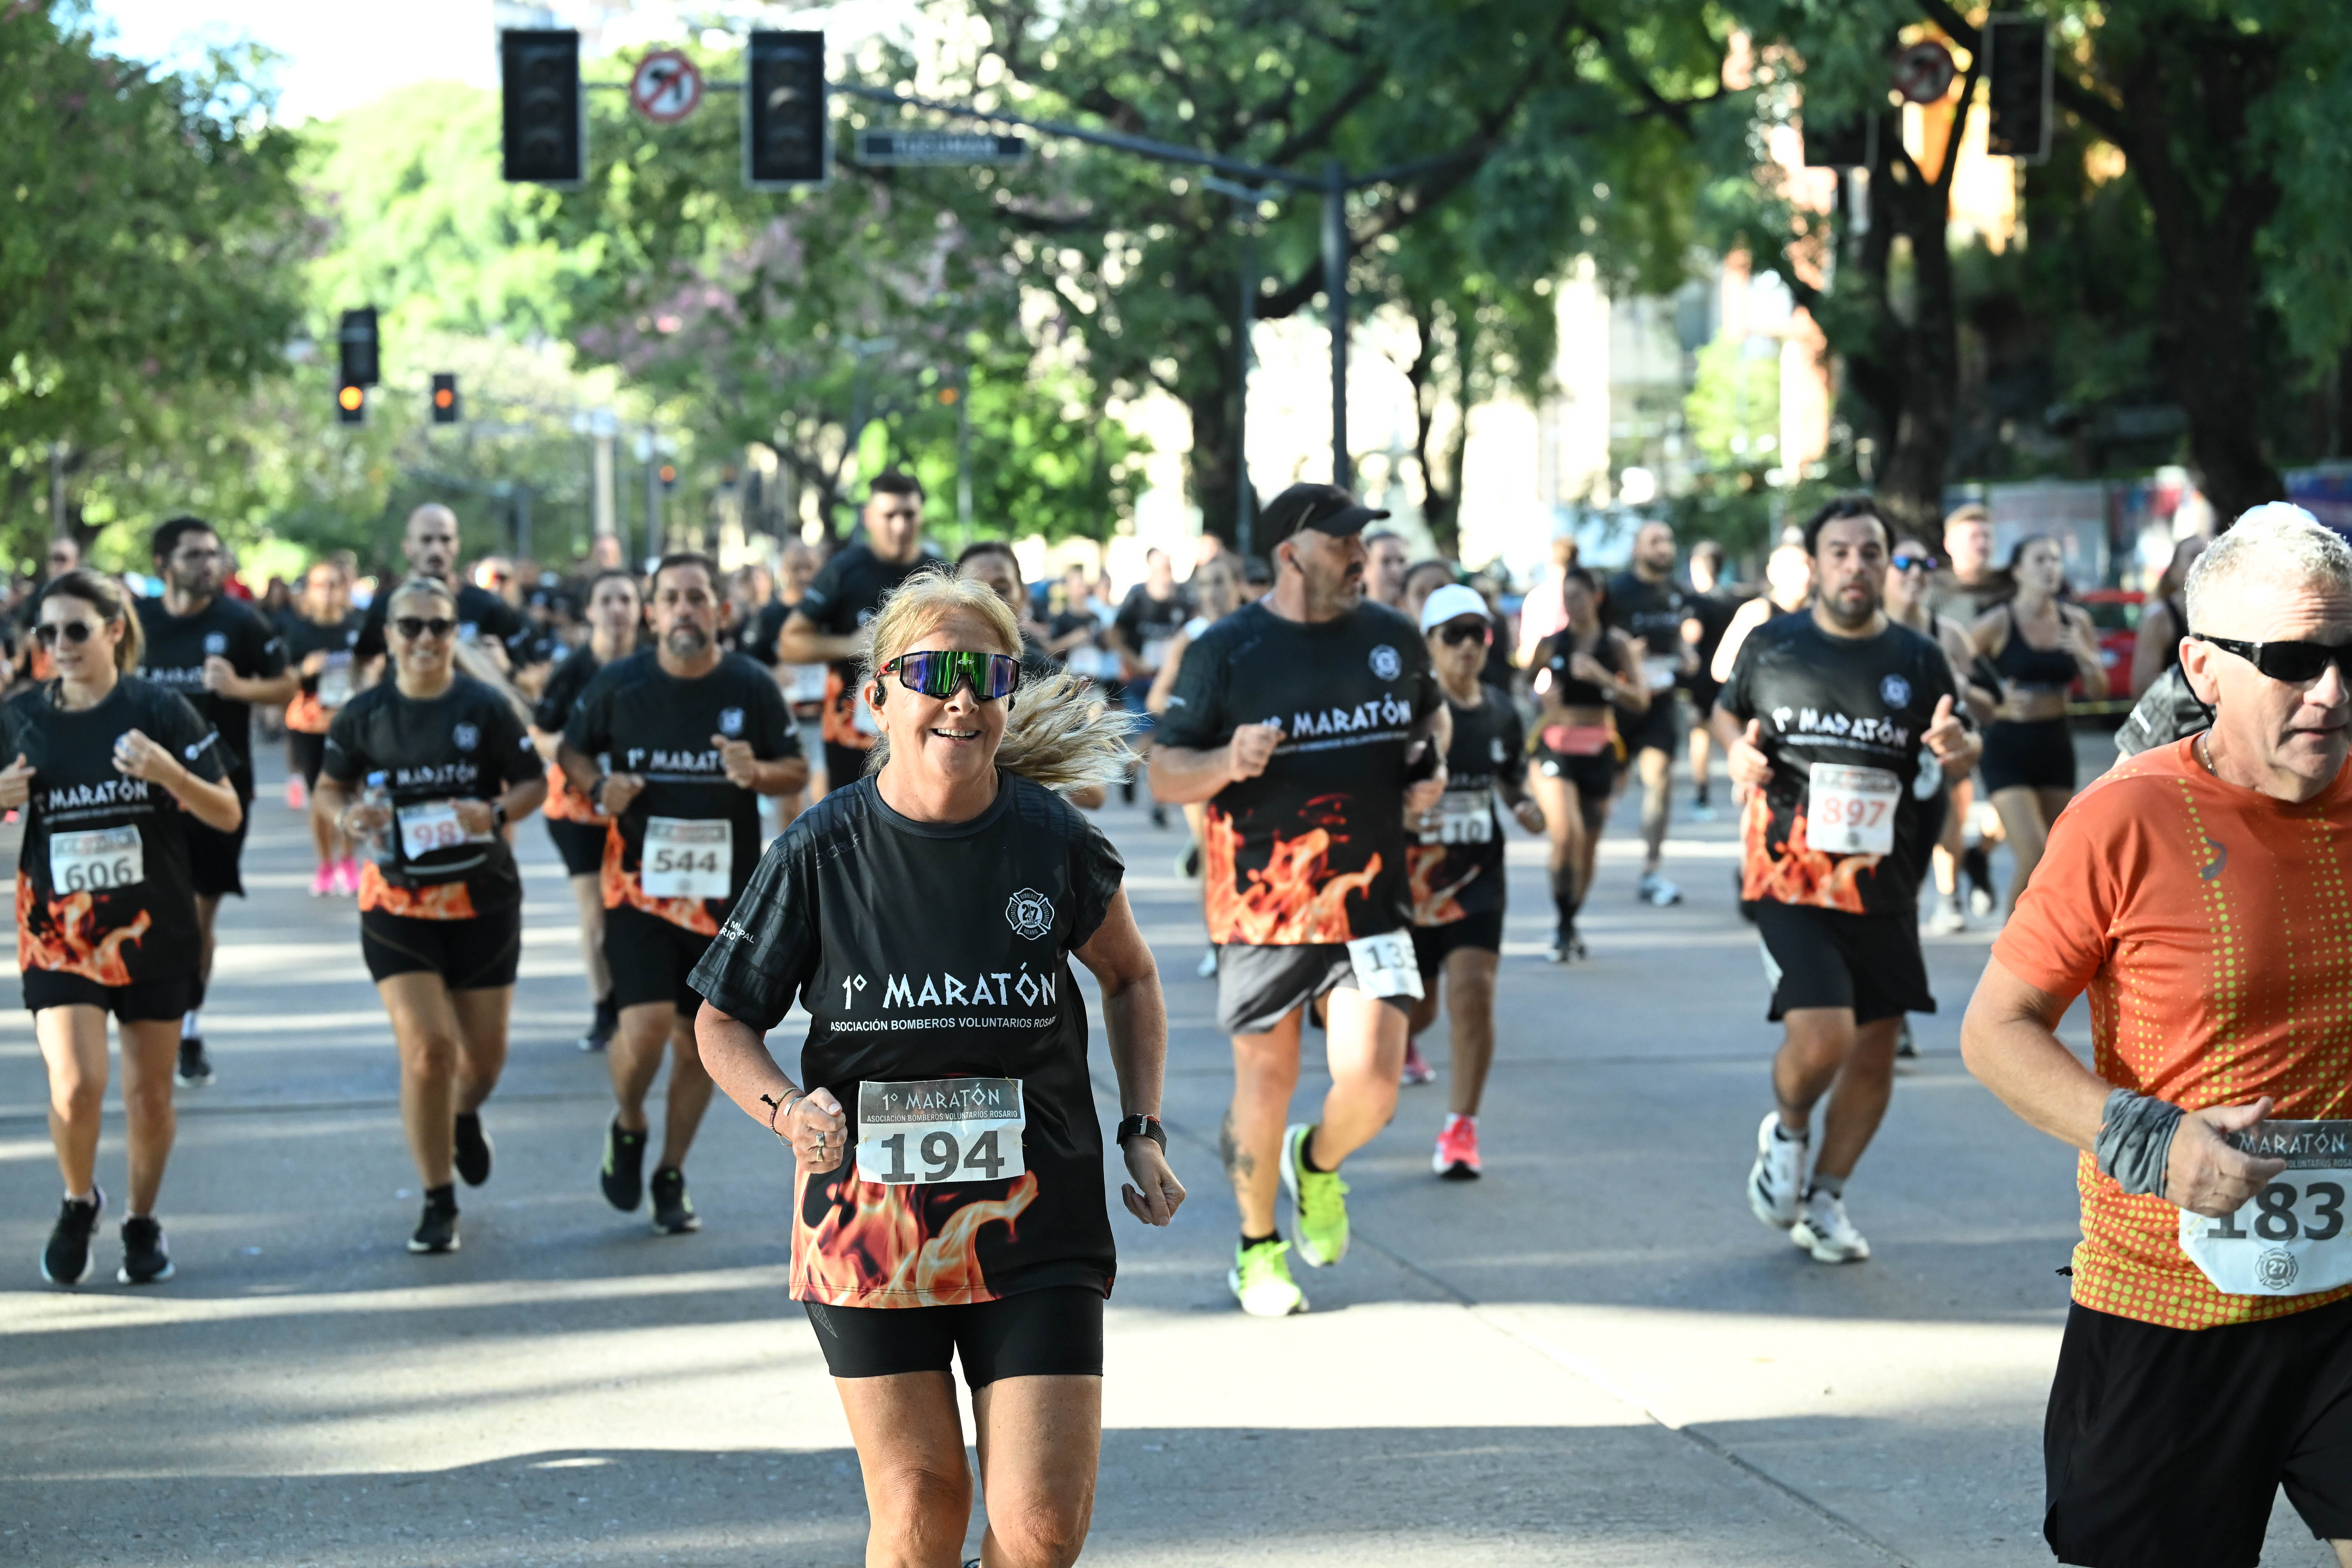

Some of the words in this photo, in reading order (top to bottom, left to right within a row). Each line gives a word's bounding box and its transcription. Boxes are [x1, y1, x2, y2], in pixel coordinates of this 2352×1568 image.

[1292, 692, 1412, 740] MARATÓN
[650, 749, 728, 772] MARAT
[49, 774, 149, 811] MARATÓN
[1823, 797, 1886, 827] 897
[66, 856, 133, 890] 606
[653, 849, 717, 874] 544
[1022, 903, 1038, 921] 27
[842, 973, 868, 1010] 1º
[882, 961, 1056, 1009] MARATÓN
[830, 1018, 888, 1032] ASOCIACIÓN
[891, 1018, 956, 1031] BOMBEROS
[958, 1017, 1032, 1028] VOLUNTARIOS
[882, 1092, 899, 1111] 1º
[905, 1082, 1000, 1110] MARATÓN
[866, 1113, 906, 1123] ASOCIACIÓN
[908, 1113, 943, 1122] BOMBEROS
[945, 1110, 988, 1120] VOLUNTARIOS
[990, 1110, 1017, 1118] ROSARIO
[2238, 1127, 2346, 1155] MARATÓN
[881, 1130, 1005, 1183] 194
[2286, 1159, 2332, 1168] OLUNTARIOS
[2269, 1260, 2286, 1275] 27
